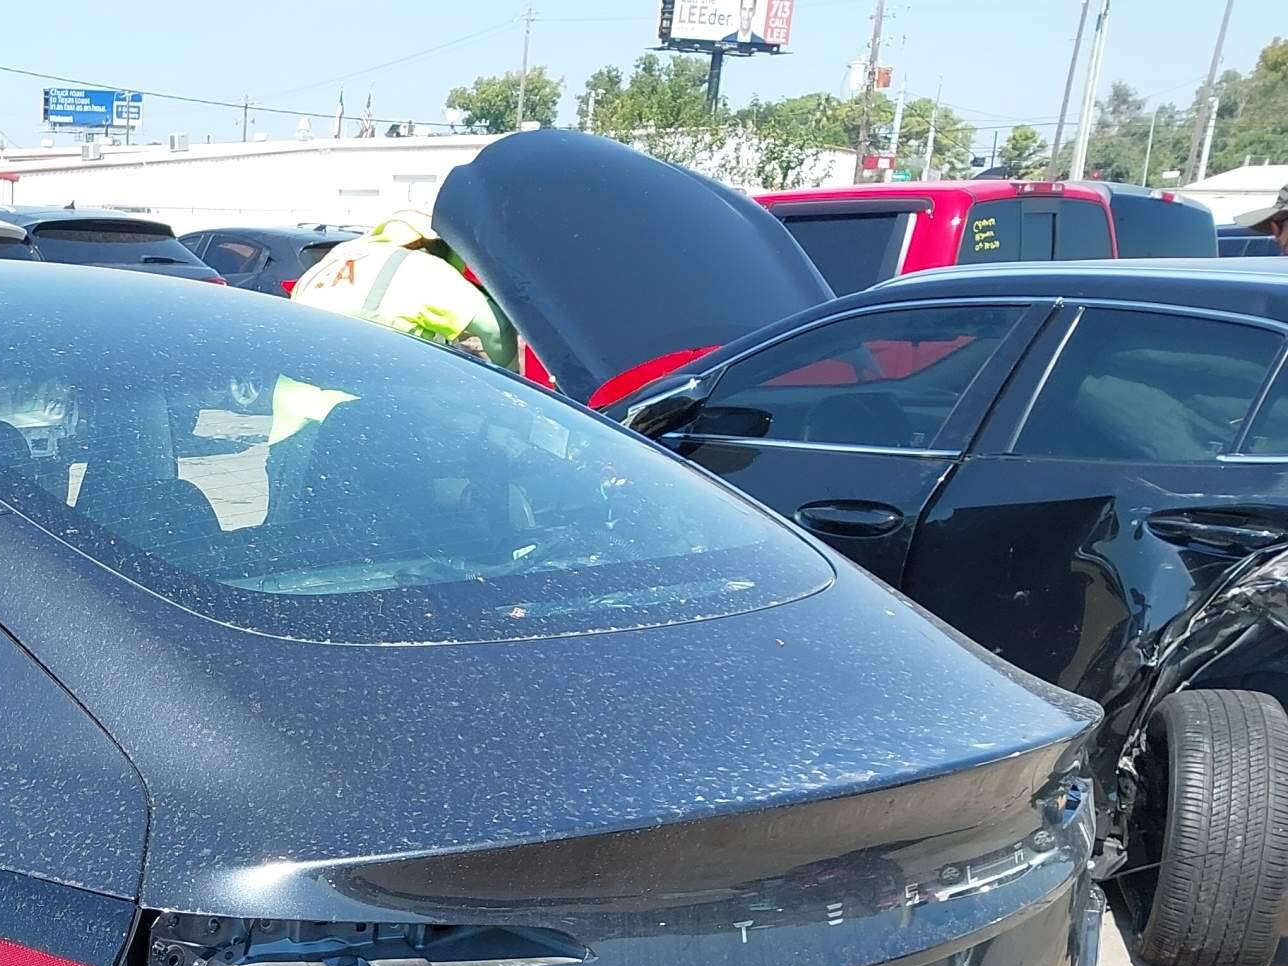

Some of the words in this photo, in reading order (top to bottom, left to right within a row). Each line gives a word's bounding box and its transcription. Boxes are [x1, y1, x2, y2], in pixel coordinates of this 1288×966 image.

[771, 1, 789, 18] 713
[769, 19, 787, 28] CALL
[766, 28, 785, 40] LEE
